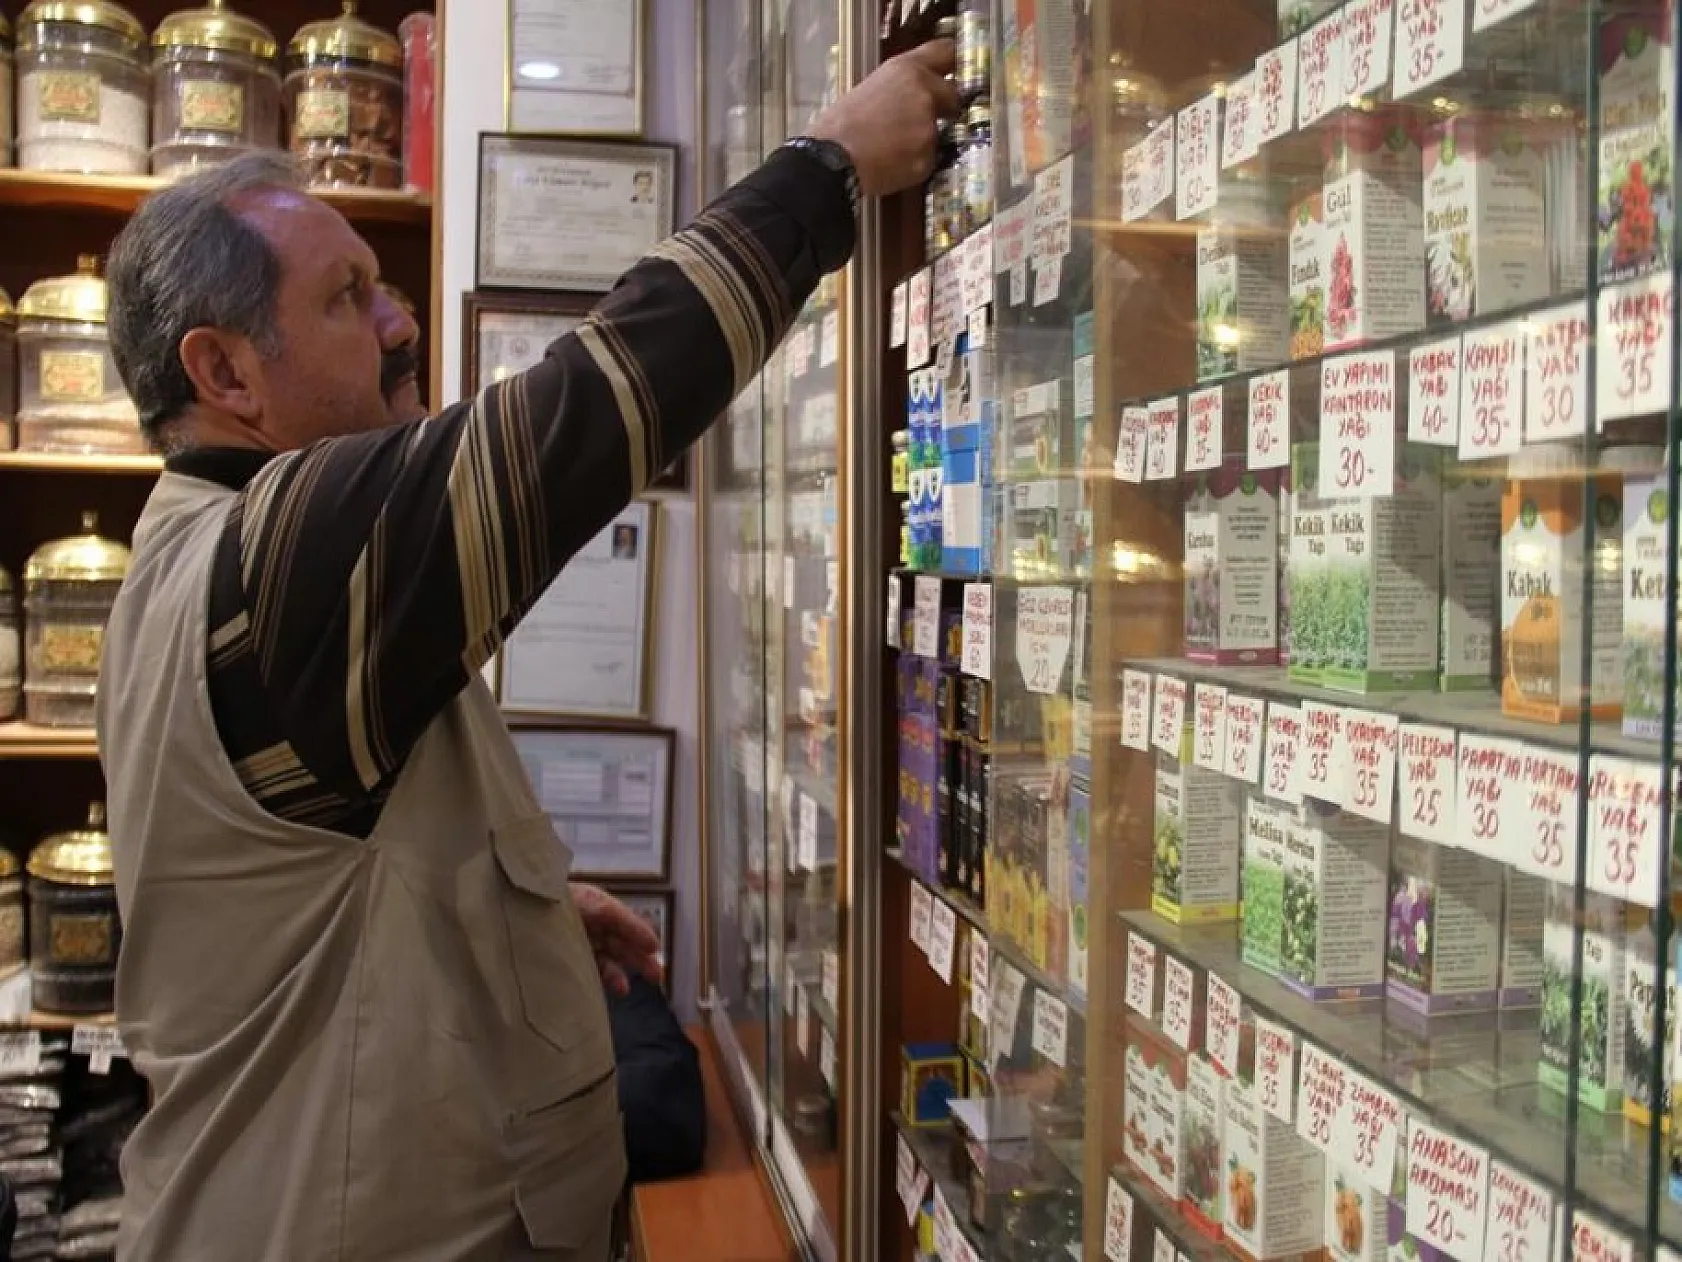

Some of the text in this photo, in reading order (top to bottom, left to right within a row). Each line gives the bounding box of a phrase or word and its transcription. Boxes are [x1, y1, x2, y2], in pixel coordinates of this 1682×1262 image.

[1326, 183, 1352, 213] Gül
[1324, 361, 1389, 391] EV YAPIMI
[1619, 353, 1656, 399] 35
[1322, 389, 1392, 418] KANTARON
[1541, 385, 1574, 428] 30
[1294, 512, 1325, 538] Kekik
[1331, 511, 1365, 537] Kekik
[1507, 570, 1552, 599] Kabak
[1629, 563, 1672, 600] Ket
[1307, 709, 1341, 735] NANE
[1308, 753, 1329, 783] 35
[1353, 769, 1380, 808] 35
[1413, 786, 1442, 827] 25
[1472, 802, 1500, 840] 30
[1532, 819, 1565, 869] 35
[1604, 838, 1640, 886] 35
[1351, 1081, 1399, 1124] ZAMBAK
[1411, 1128, 1480, 1180] ANASON
[1410, 1162, 1480, 1212] AROMASI
